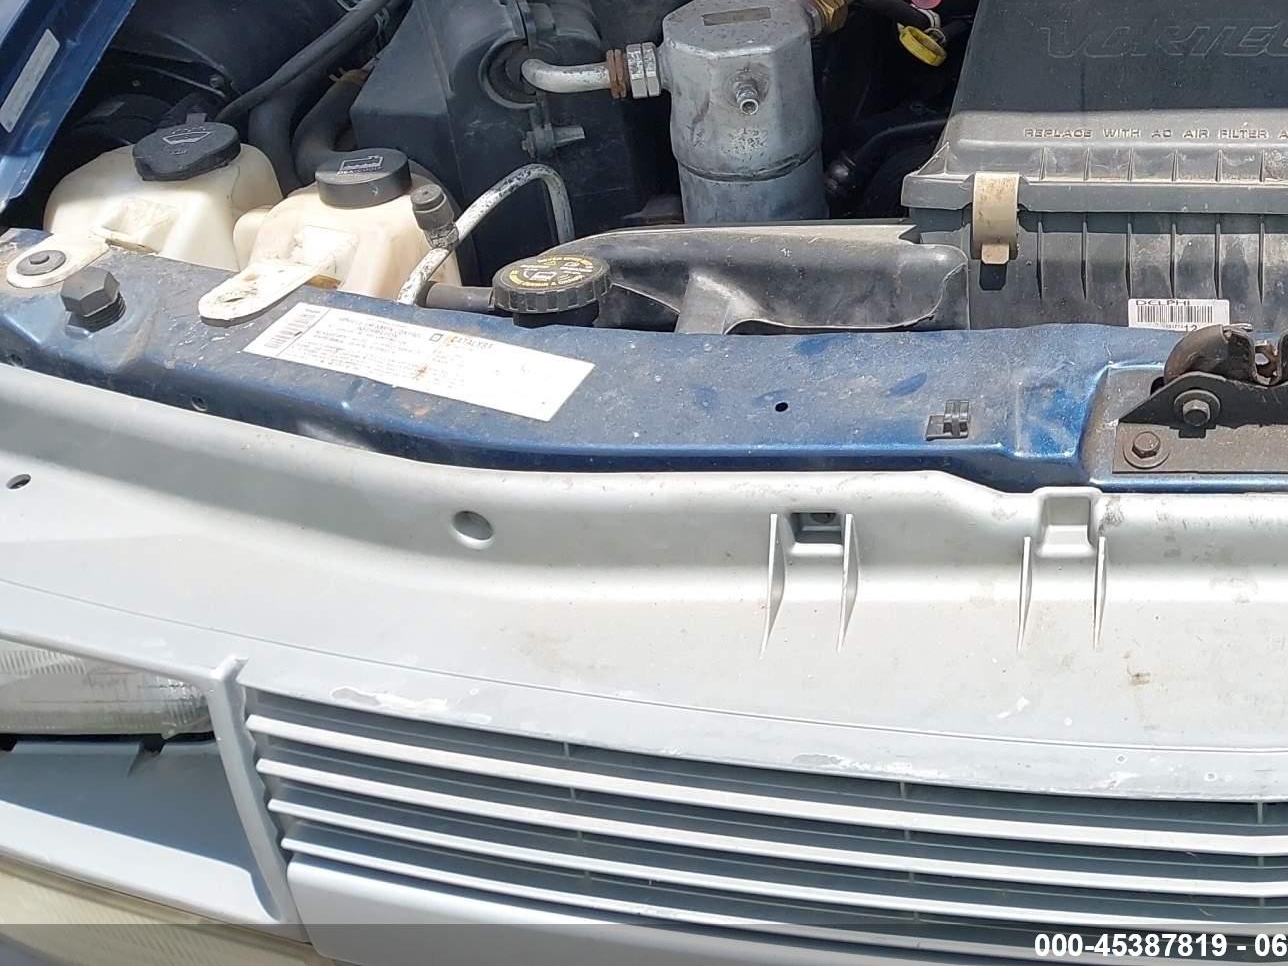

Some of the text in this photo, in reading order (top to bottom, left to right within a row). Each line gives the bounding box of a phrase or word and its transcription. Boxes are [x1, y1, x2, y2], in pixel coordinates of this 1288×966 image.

[1024, 128, 1093, 138] REPLACE
[1102, 128, 1141, 138] WITH
[1183, 128, 1209, 139] AIR
[1218, 128, 1269, 139] FILTER
